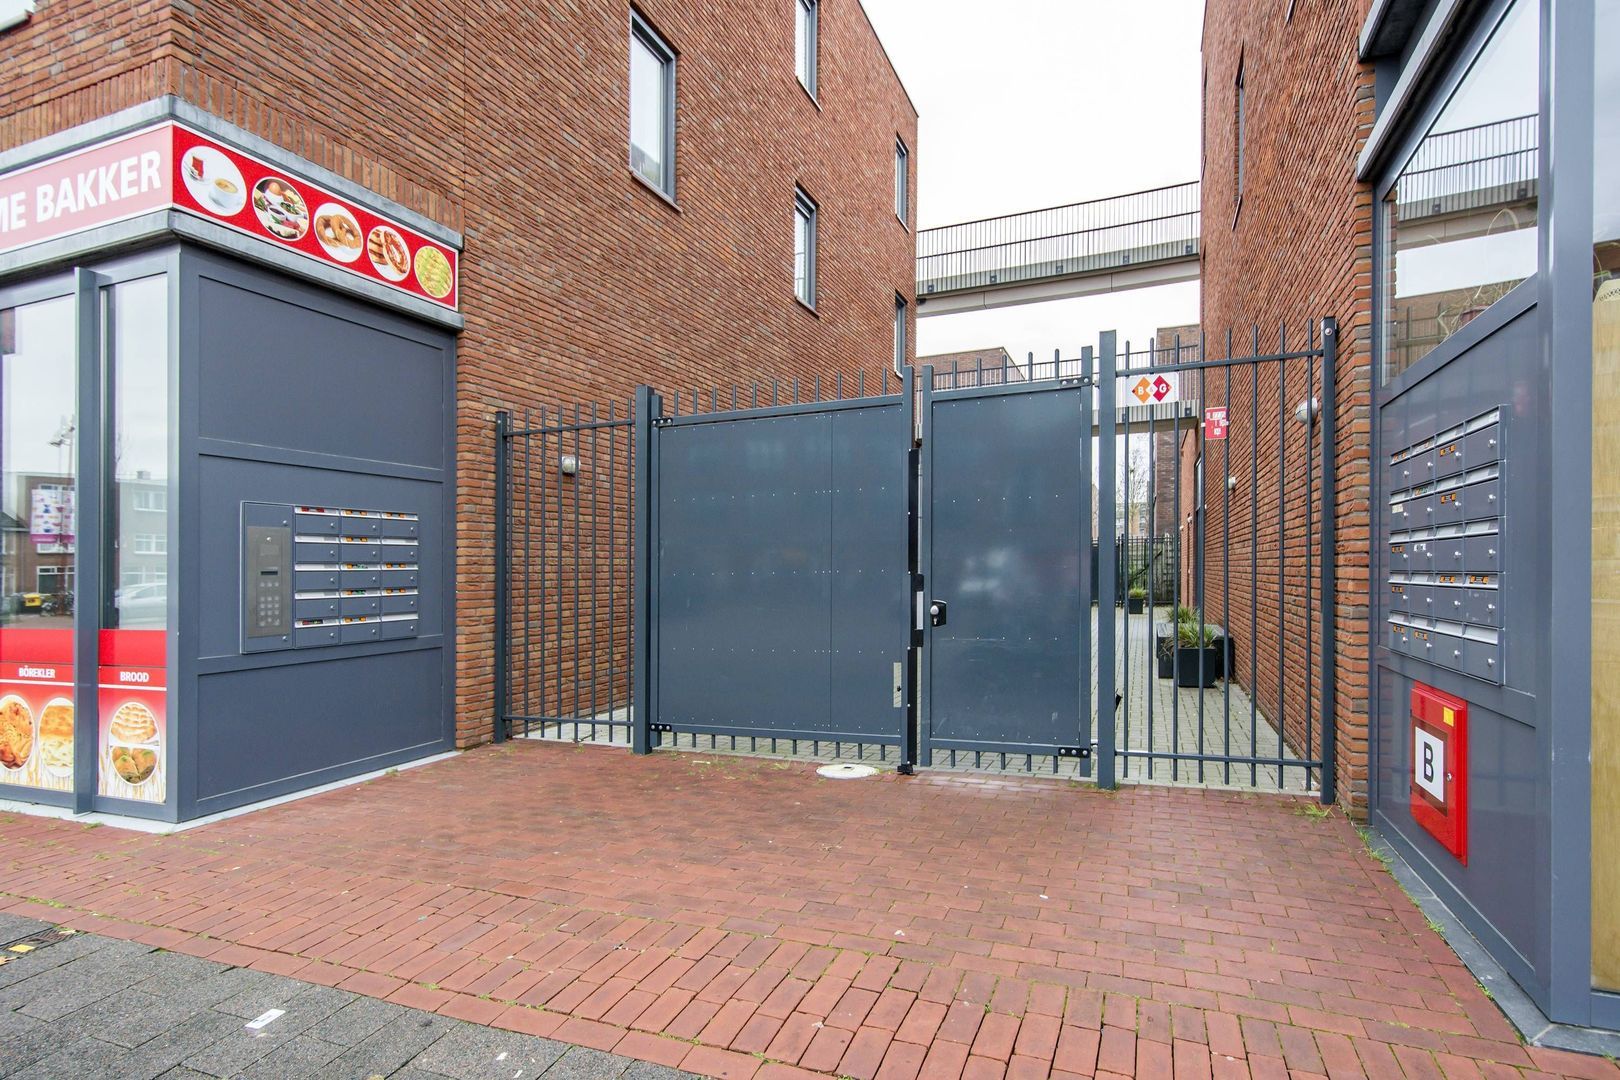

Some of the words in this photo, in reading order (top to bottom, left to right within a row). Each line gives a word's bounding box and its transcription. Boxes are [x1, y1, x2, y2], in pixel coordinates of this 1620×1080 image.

[36, 150, 162, 223] BAKKER
[1137, 386, 1144, 395] B
[1159, 383, 1168, 393] G
[119, 671, 150, 683] BROOD
[1423, 741, 1434, 784] B
